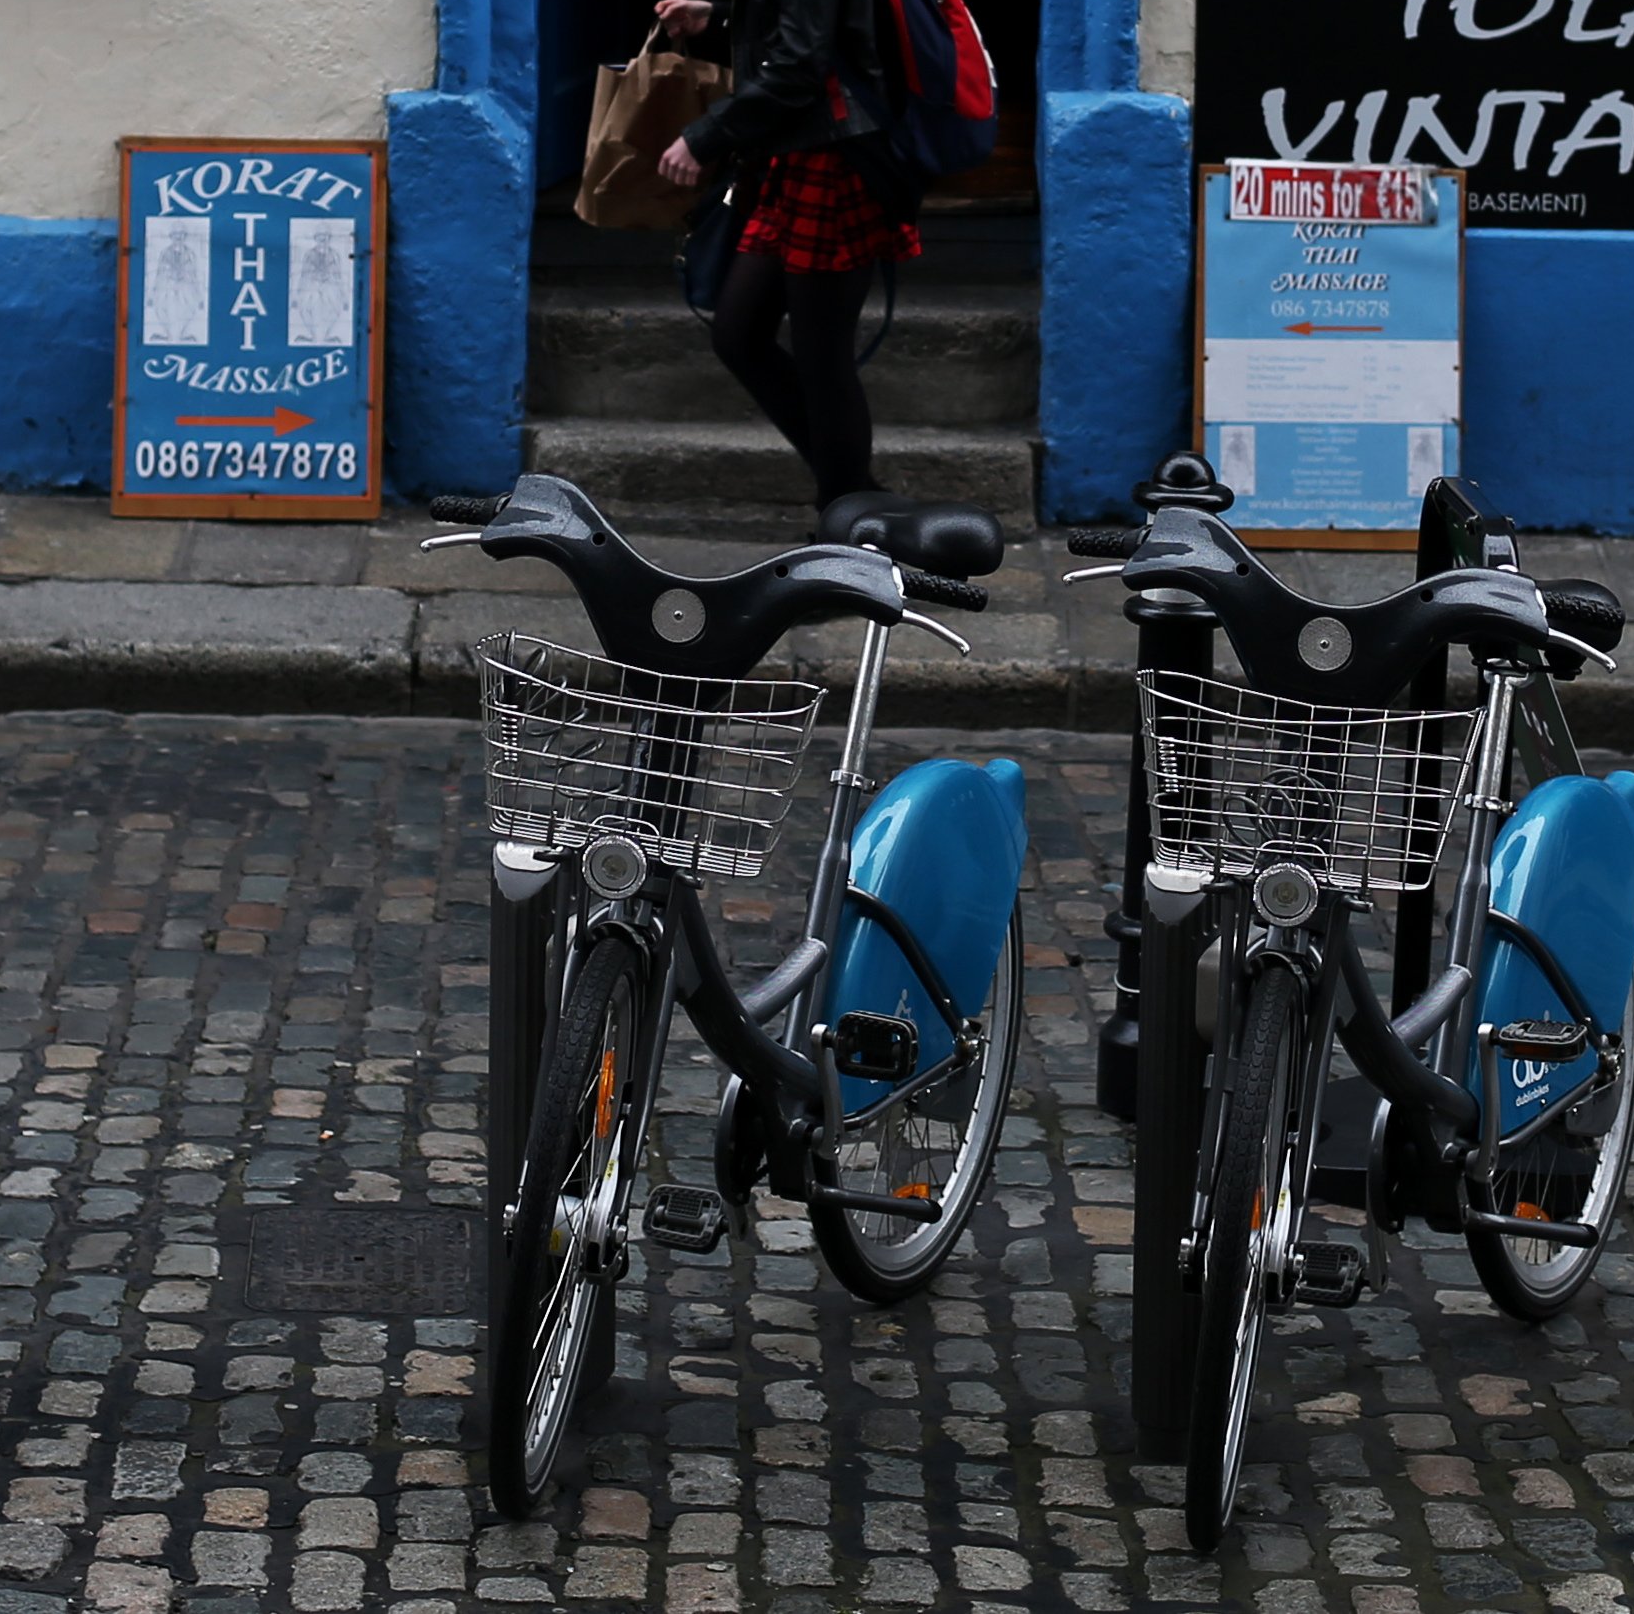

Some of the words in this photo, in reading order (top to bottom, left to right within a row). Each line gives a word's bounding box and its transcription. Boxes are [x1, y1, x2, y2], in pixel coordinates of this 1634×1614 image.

[154, 158, 363, 216] KORAT
[1235, 165, 1264, 216] 20
[1269, 167, 1326, 218] mins
[1331, 169, 1364, 218] for
[1466, 191, 1587, 218] BASEMENT)
[1292, 222, 1366, 244] KORAT
[1302, 246, 1360, 265] THAI
[230, 213, 267, 351] THAI
[1271, 272, 1389, 292] MASSAGE
[1271, 300, 1305, 318] 086
[1311, 300, 1390, 318] 7347878
[143, 348, 349, 395] MASSAGE
[135, 440, 357, 480] 0867347878
